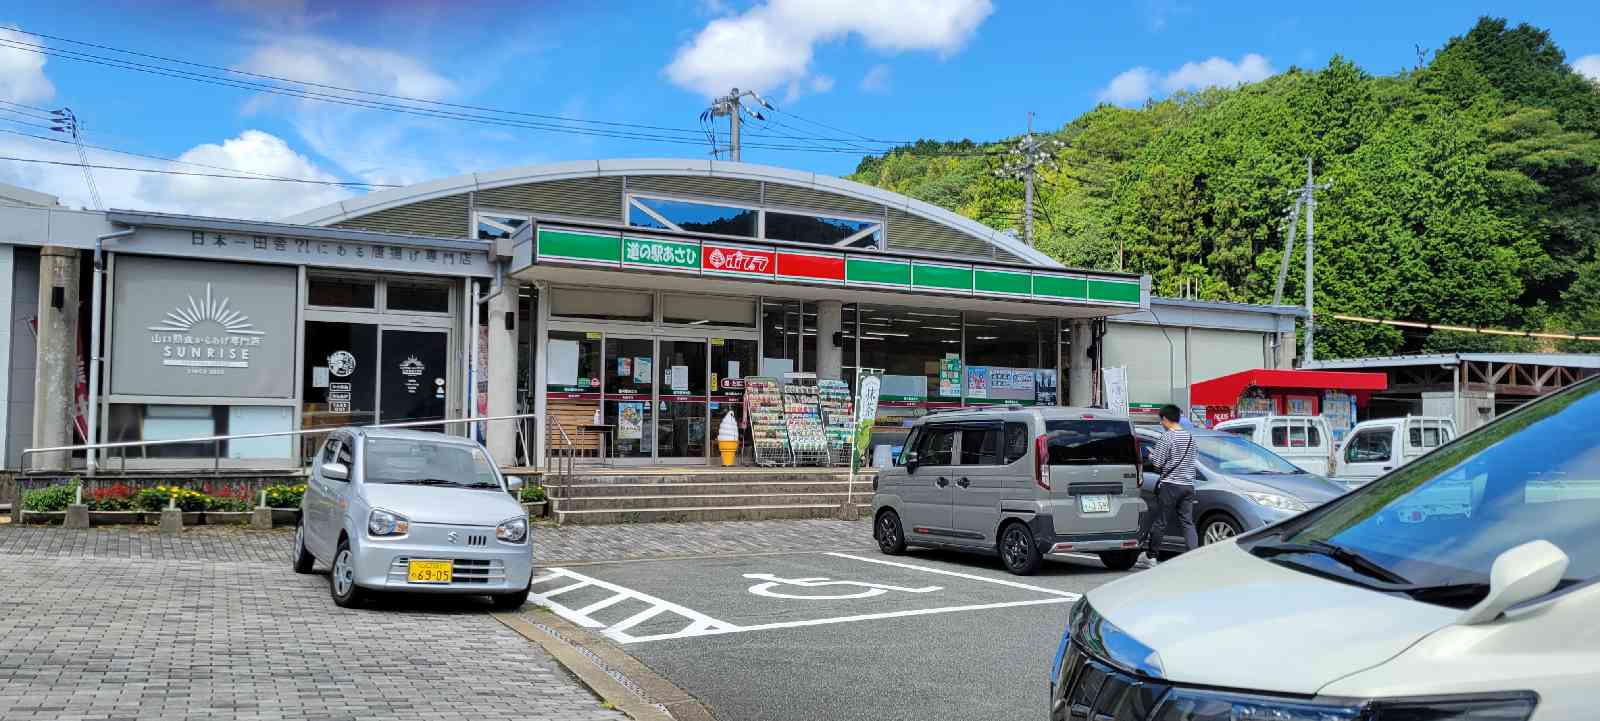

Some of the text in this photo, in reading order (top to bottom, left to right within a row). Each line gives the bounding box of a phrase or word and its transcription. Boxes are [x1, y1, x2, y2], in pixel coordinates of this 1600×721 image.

[626, 241, 697, 265] 道の駅あさひ
[724, 250, 769, 272] ポプラ
[162, 345, 249, 360] SUNRISE
[417, 569, 449, 581] 69-05
